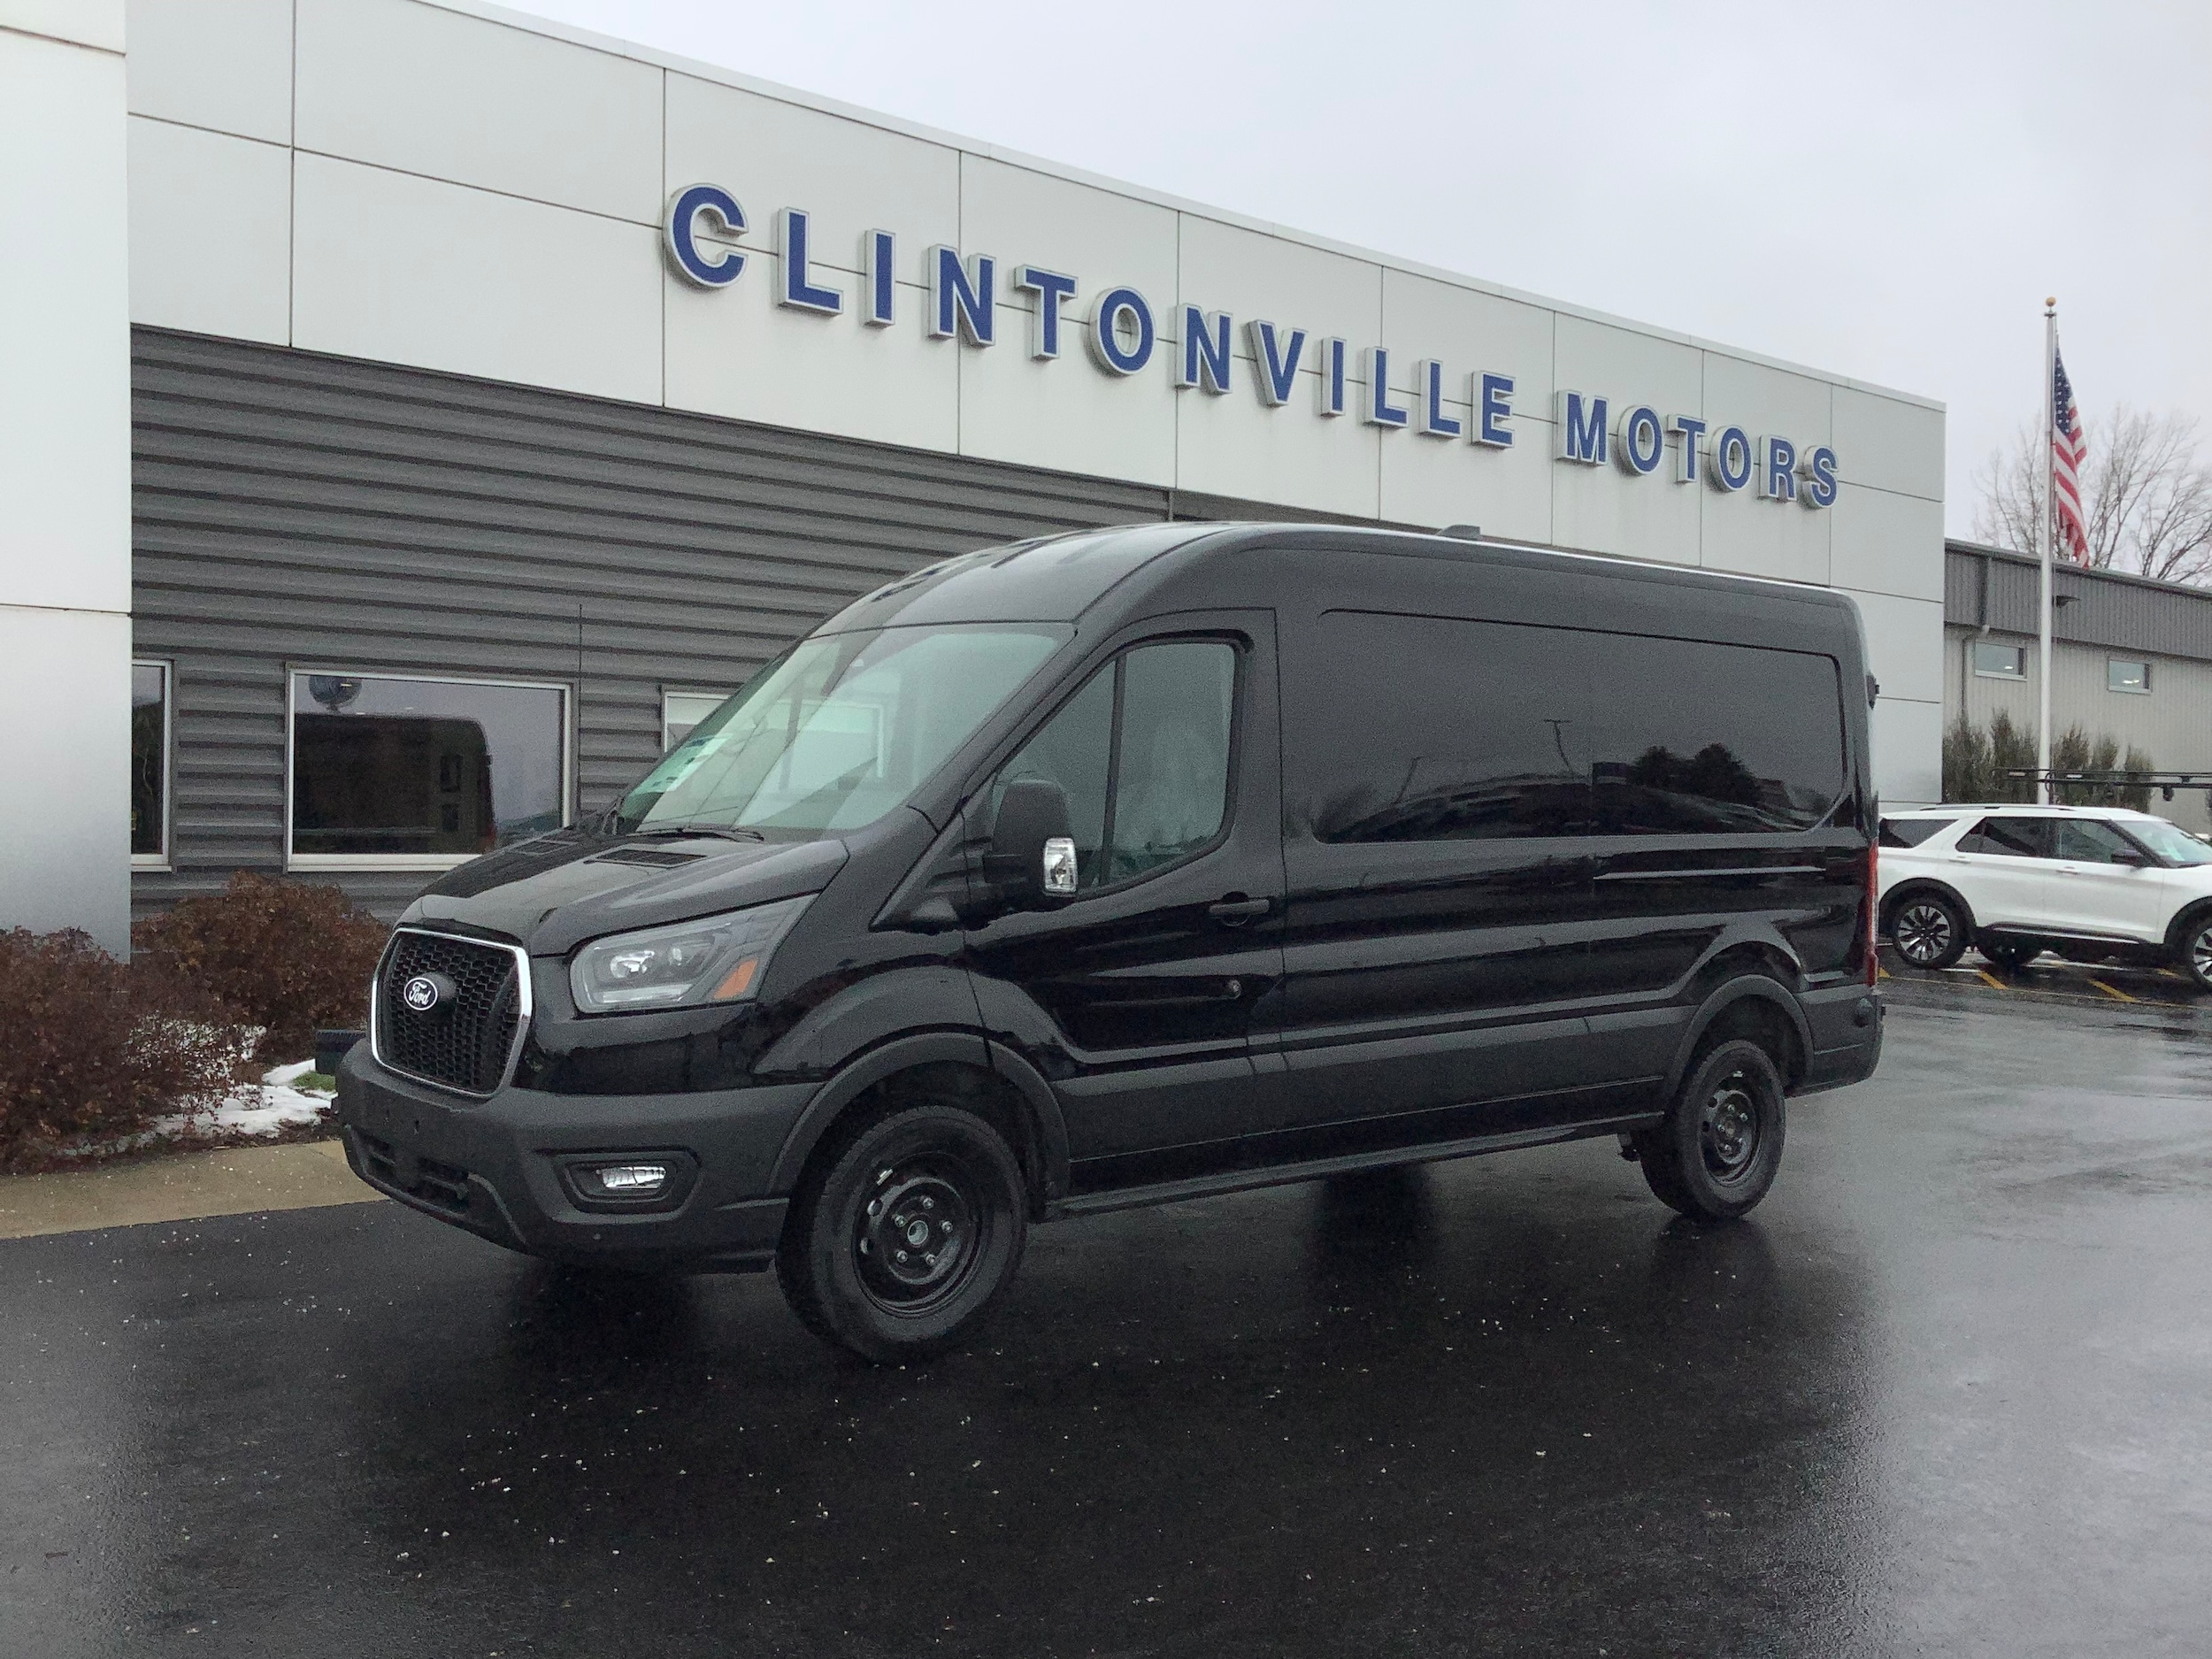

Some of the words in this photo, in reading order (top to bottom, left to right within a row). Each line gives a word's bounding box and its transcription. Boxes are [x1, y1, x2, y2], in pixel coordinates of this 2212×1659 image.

[663, 182, 1517, 449] CLINTONVILLE
[1555, 388, 1840, 509] MOTORS
[408, 981, 432, 1006] Ford
